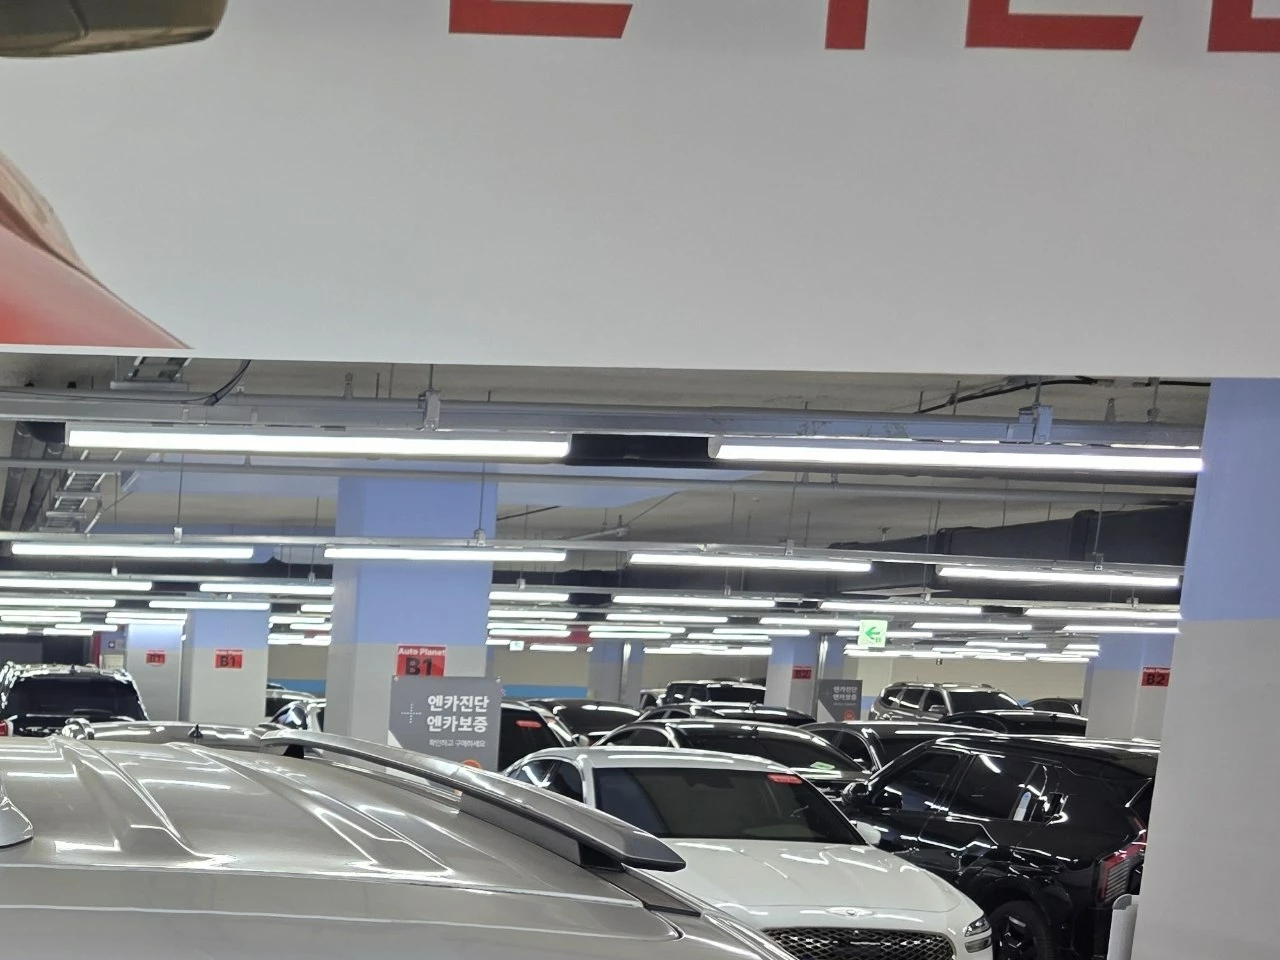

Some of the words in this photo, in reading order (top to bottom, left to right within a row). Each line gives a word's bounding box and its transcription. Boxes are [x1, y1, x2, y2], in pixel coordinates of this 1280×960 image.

[398, 647, 419, 656] Auto
[420, 648, 447, 657] Planet
[220, 655, 236, 667] B1
[405, 657, 433, 676] B1
[1147, 672, 1165, 686] B2
[427, 694, 490, 713] 엔카진단
[426, 715, 489, 733] 엔카보증
